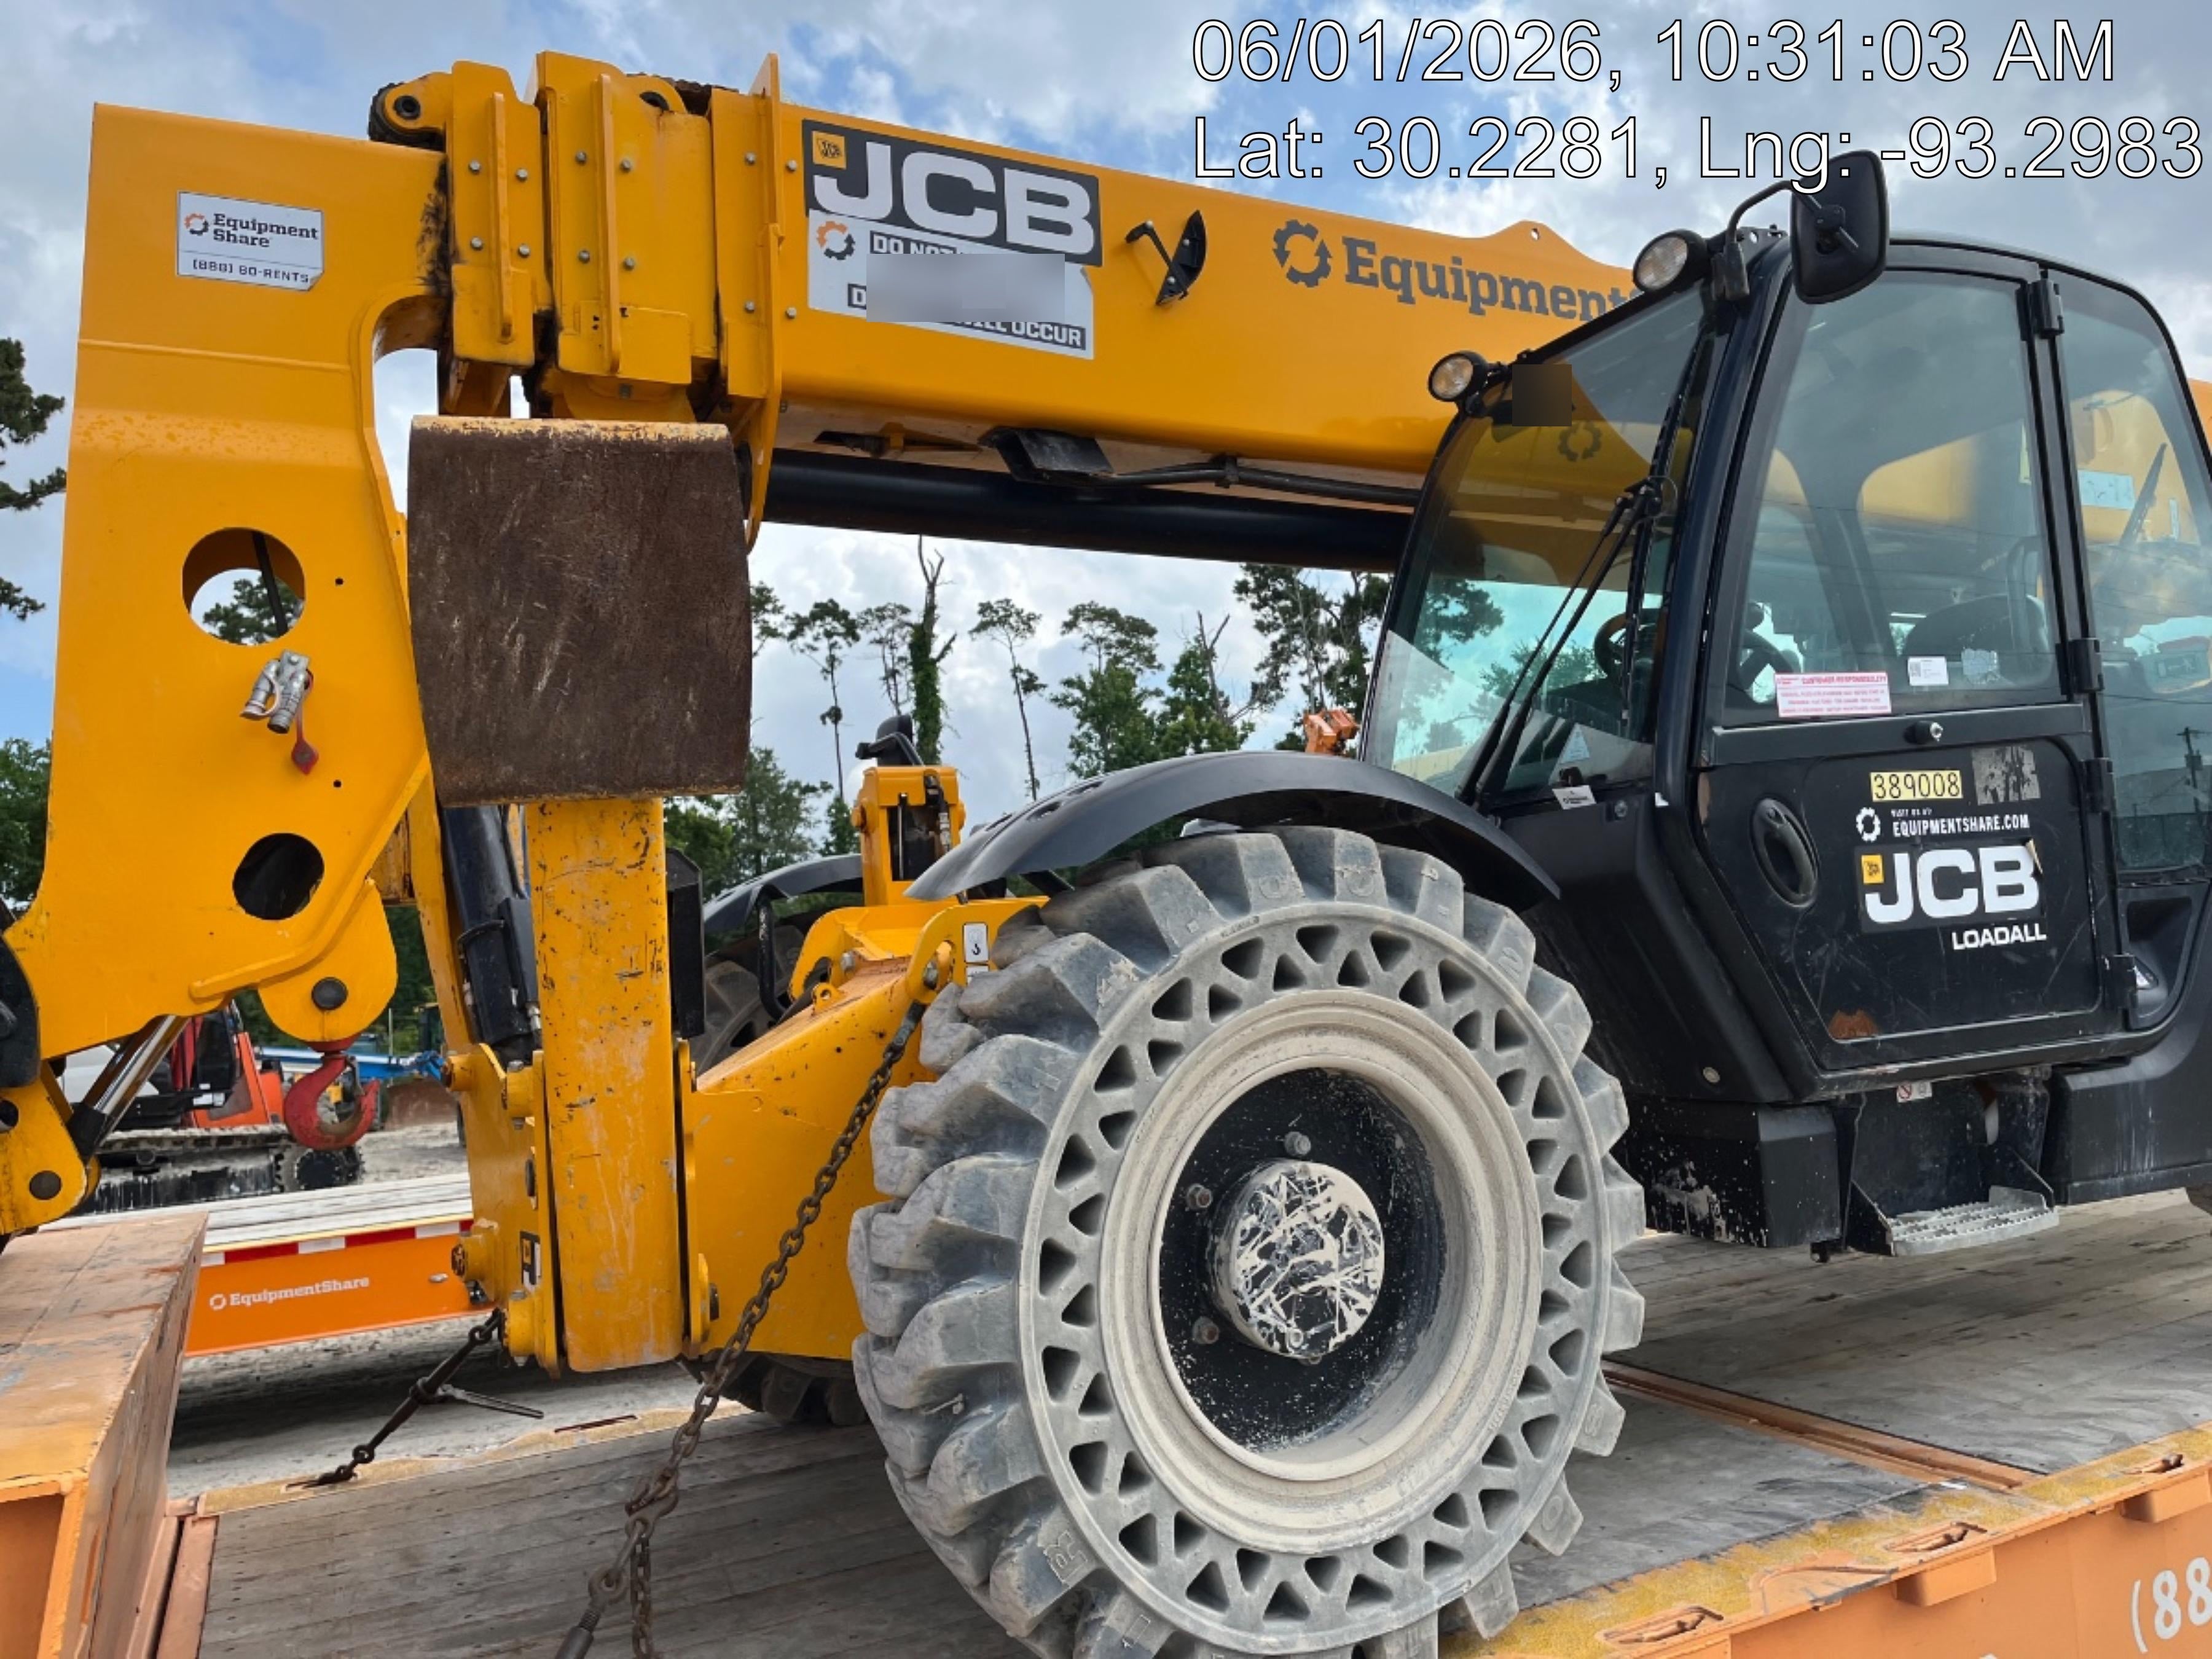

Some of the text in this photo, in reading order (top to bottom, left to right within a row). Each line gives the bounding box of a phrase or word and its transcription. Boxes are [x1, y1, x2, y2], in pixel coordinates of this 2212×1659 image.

[813, 141, 1095, 256] JCB
[213, 213, 319, 240] Equipment
[213, 228, 270, 247] Share
[873, 233, 904, 254] DO
[1011, 322, 1081, 346] OCCUR
[1873, 772, 1960, 799] 389008
[1892, 814, 2030, 837] EQUIPMENTSHARE.COM
[1864, 845, 2039, 923] JCB
[1951, 923, 2046, 950] LOADALL
[230, 1277, 369, 1308] EquipmentShare
